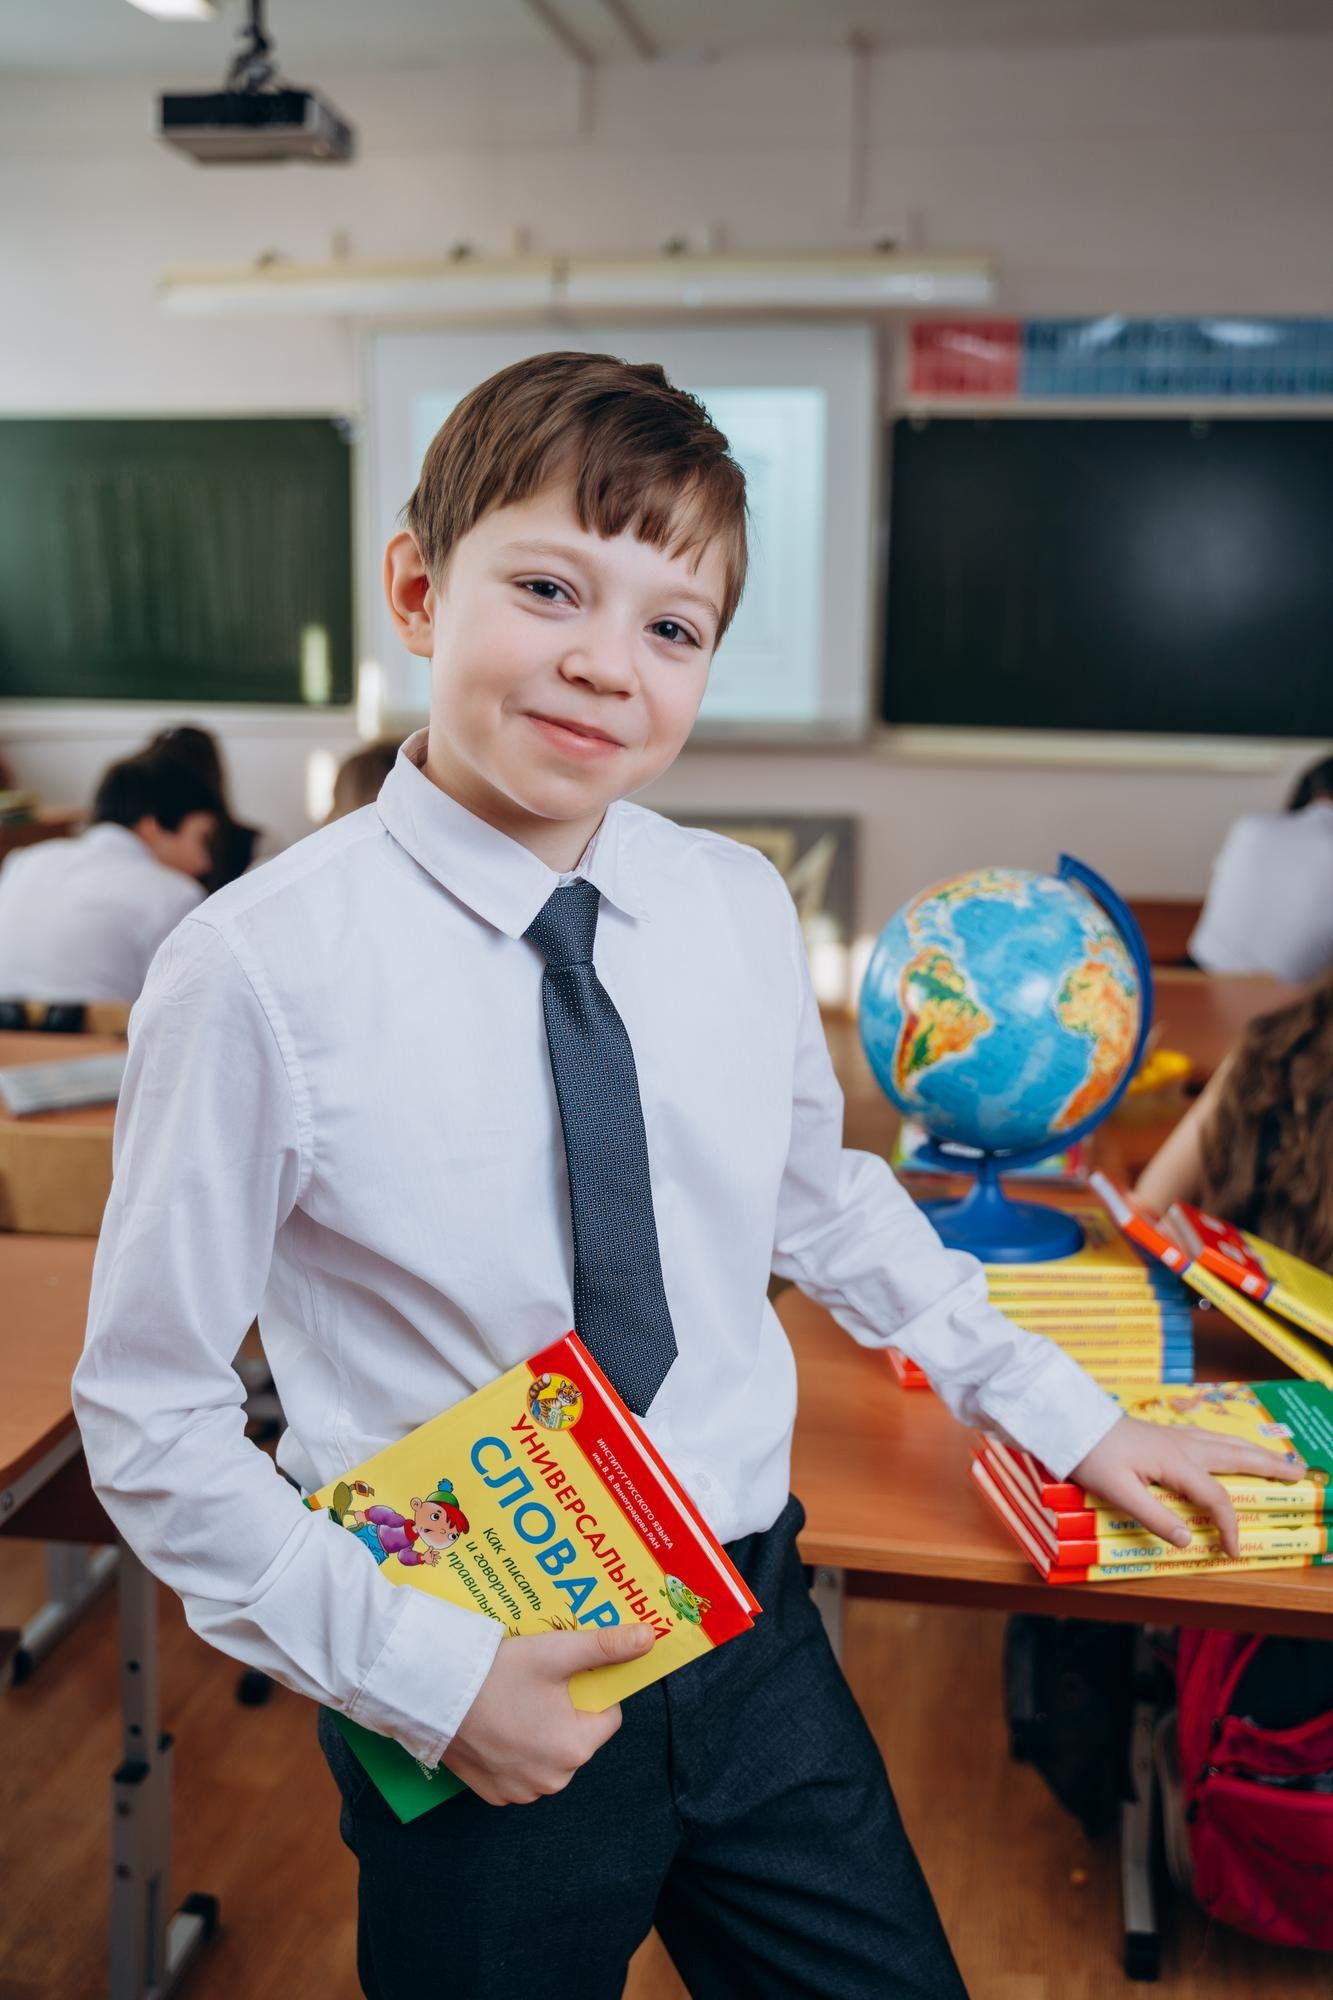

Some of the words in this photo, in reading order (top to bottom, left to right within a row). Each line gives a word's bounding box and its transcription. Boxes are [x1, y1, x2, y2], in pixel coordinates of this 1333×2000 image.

[471, 1436, 620, 1629] СЛОВАР
[511, 1413, 673, 1640] УНИВЕРСАЛЬНЫЙ
[596, 1438, 628, 1480] ИНСТИТУТ
[625, 1480, 655, 1521] РУССКОГО
[652, 1521, 674, 1549] ЯЗЫКА
[613, 1482, 647, 1534] Виноградова
[646, 1532, 661, 1549] РАН
[465, 1541, 478, 1553] и
[473, 1553, 521, 1621] говорить
[483, 1527, 506, 1555] Как
[502, 1557, 542, 1612] писать
